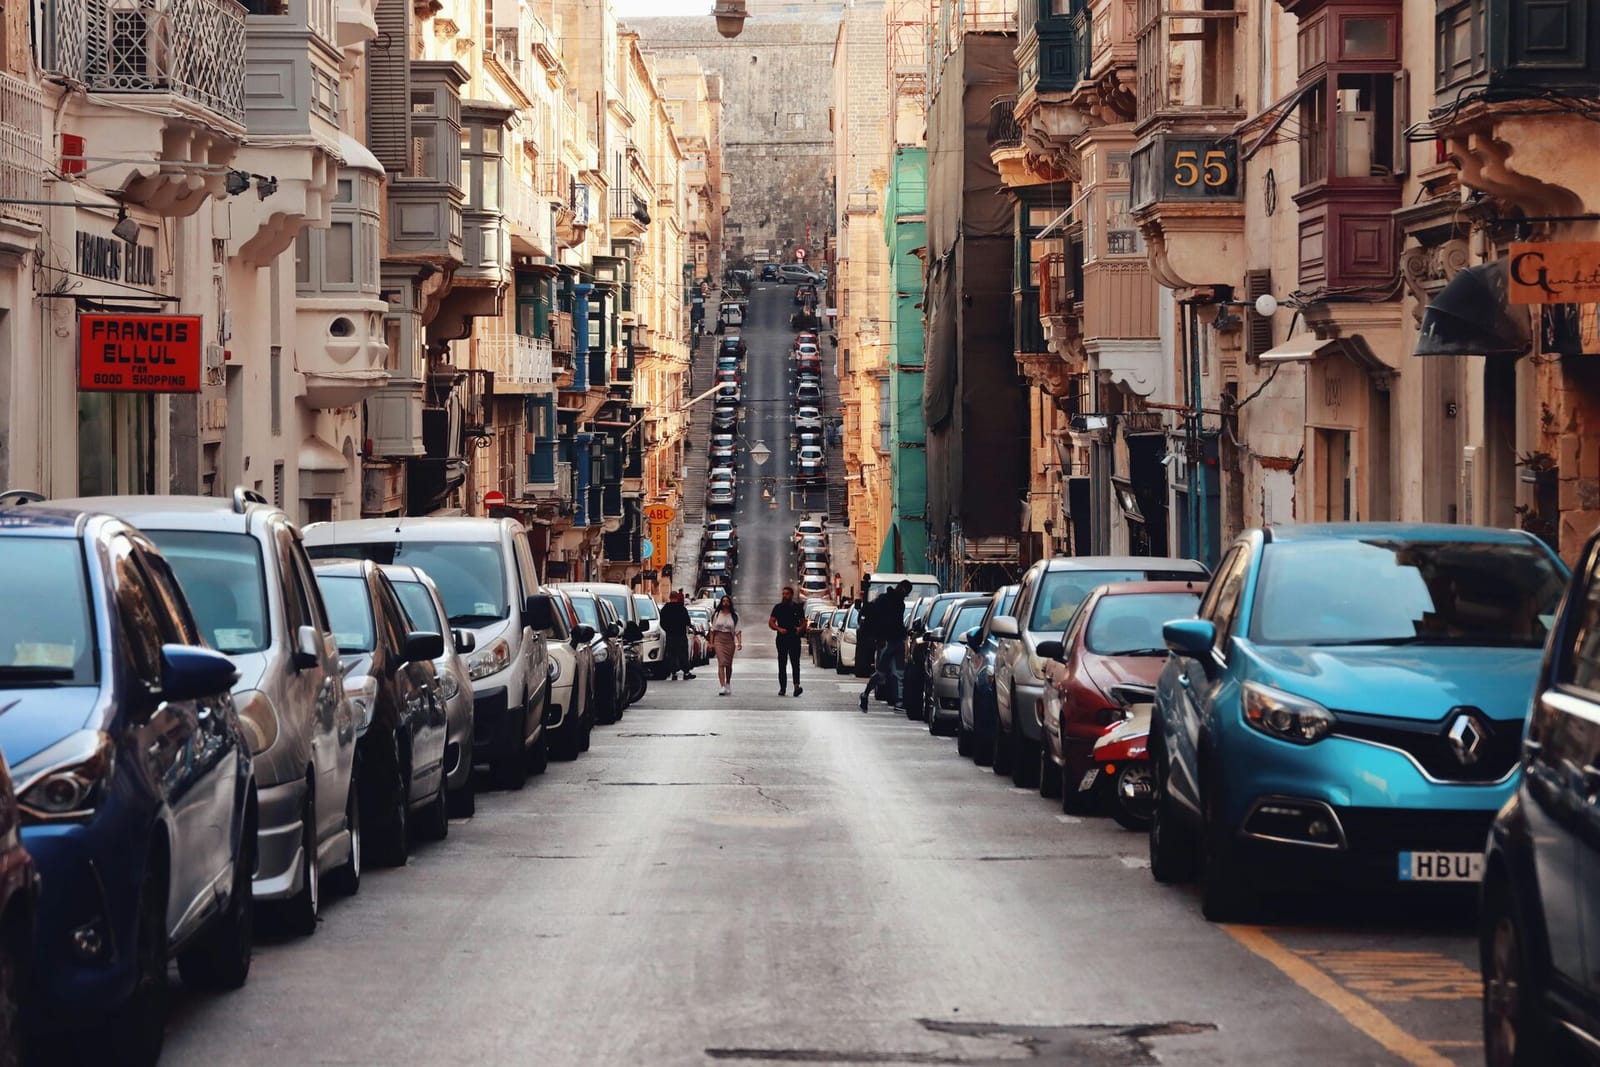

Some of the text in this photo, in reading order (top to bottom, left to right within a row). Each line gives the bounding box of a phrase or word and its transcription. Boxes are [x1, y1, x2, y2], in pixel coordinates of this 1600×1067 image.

[1174, 150, 1228, 187] 55
[92, 321, 187, 342] FRANCIS
[103, 344, 176, 364] ELLUL
[94, 373, 185, 386] GOOD SHOPPING
[649, 509, 669, 520] ABC
